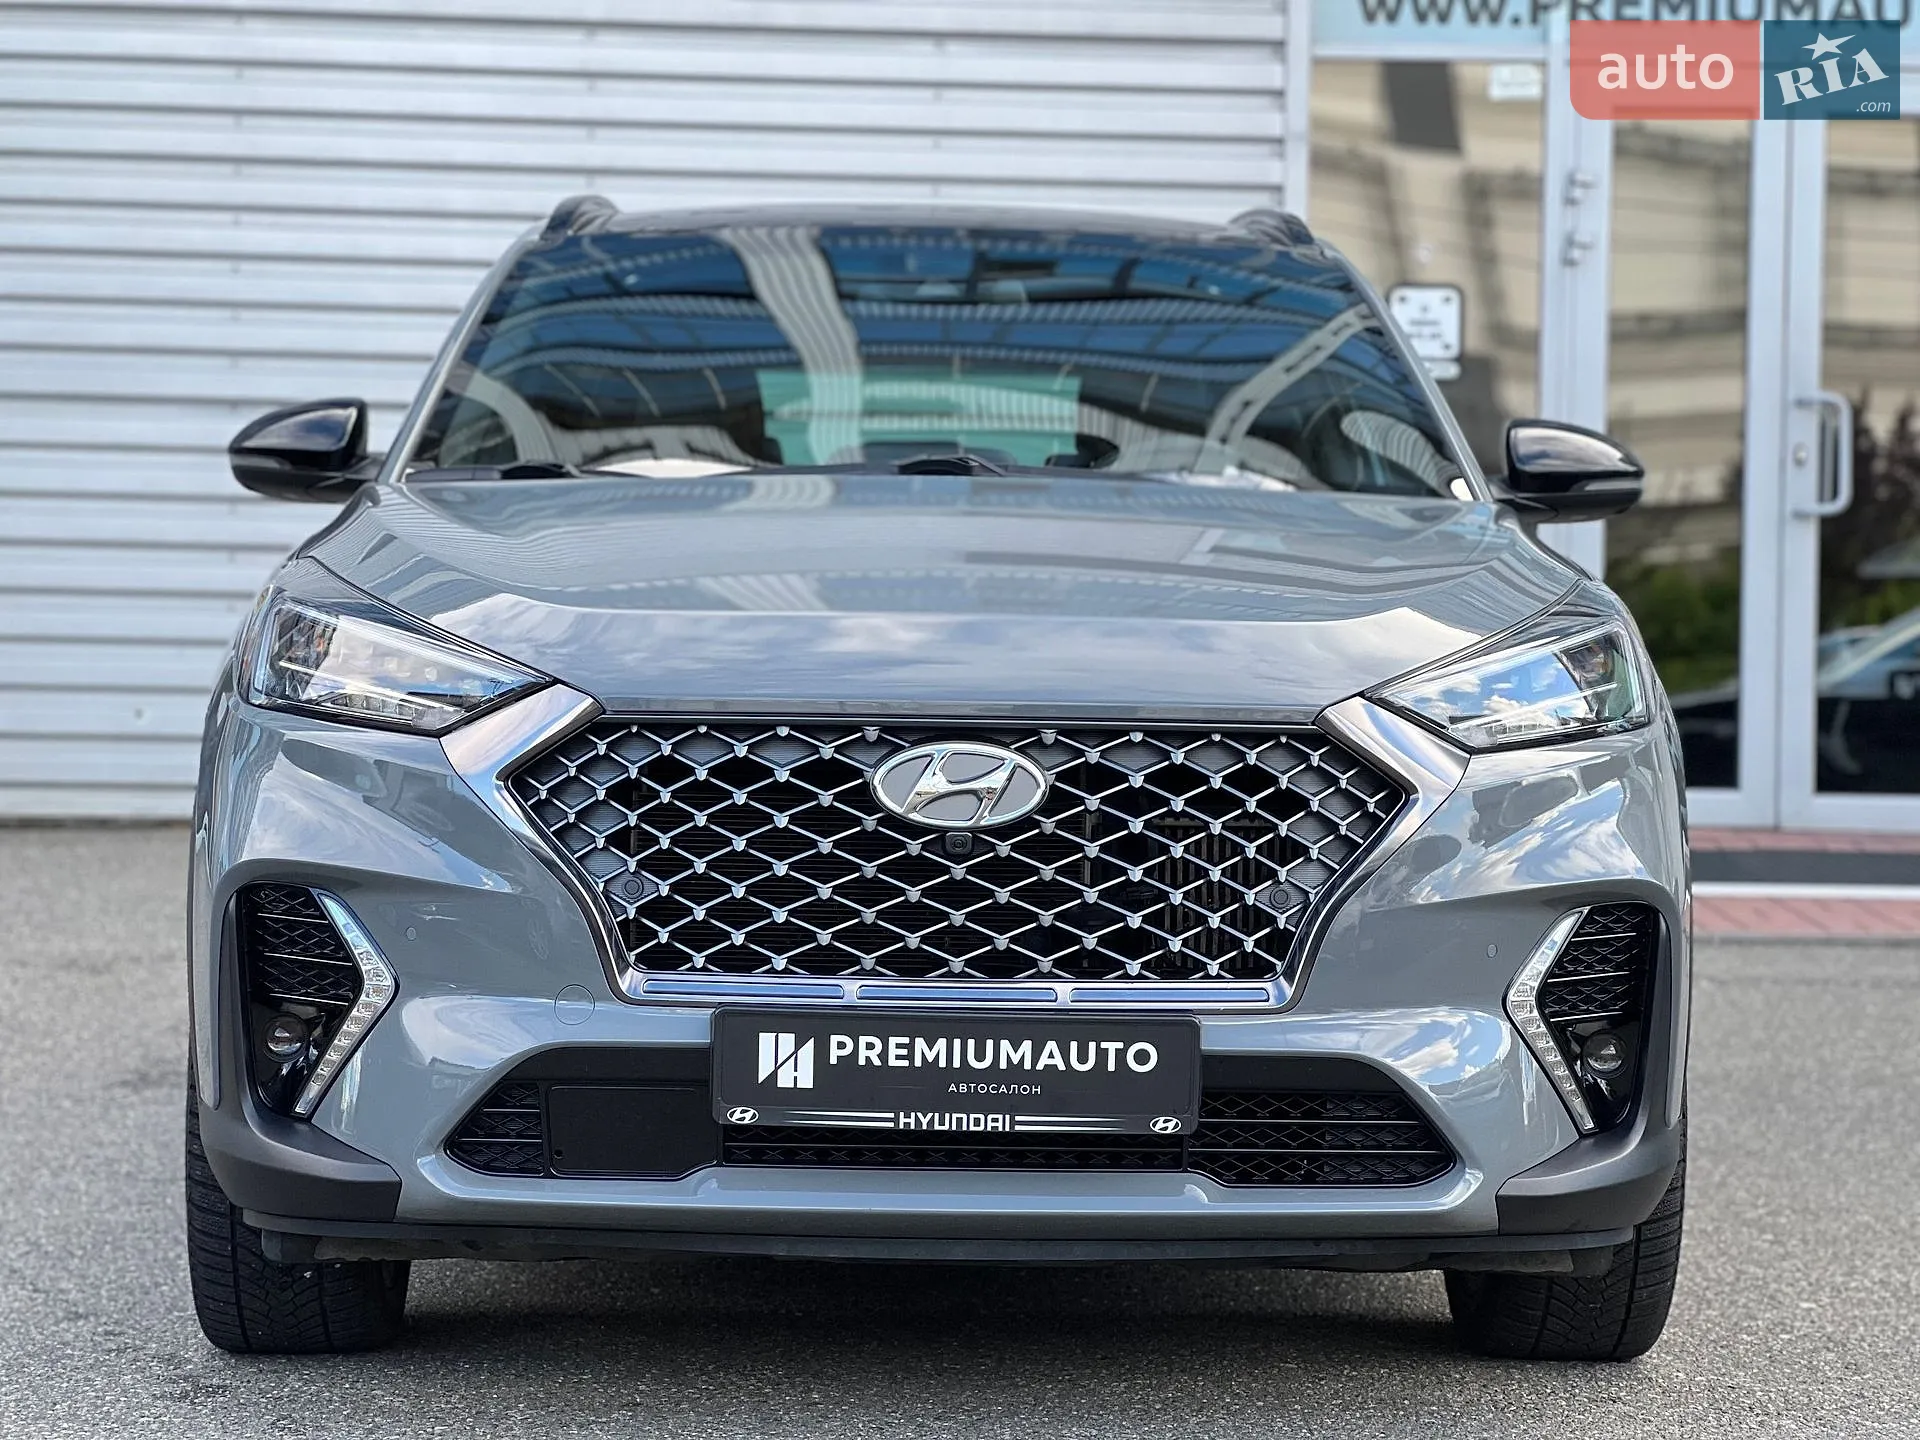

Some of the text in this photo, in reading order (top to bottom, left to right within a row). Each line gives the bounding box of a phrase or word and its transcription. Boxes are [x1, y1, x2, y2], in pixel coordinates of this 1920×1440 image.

[829, 1034, 1159, 1073] PREMIUMAUTO
[947, 1082, 1042, 1096] АВТОСАЛОН
[899, 1111, 1011, 1132] HYUNDAI
